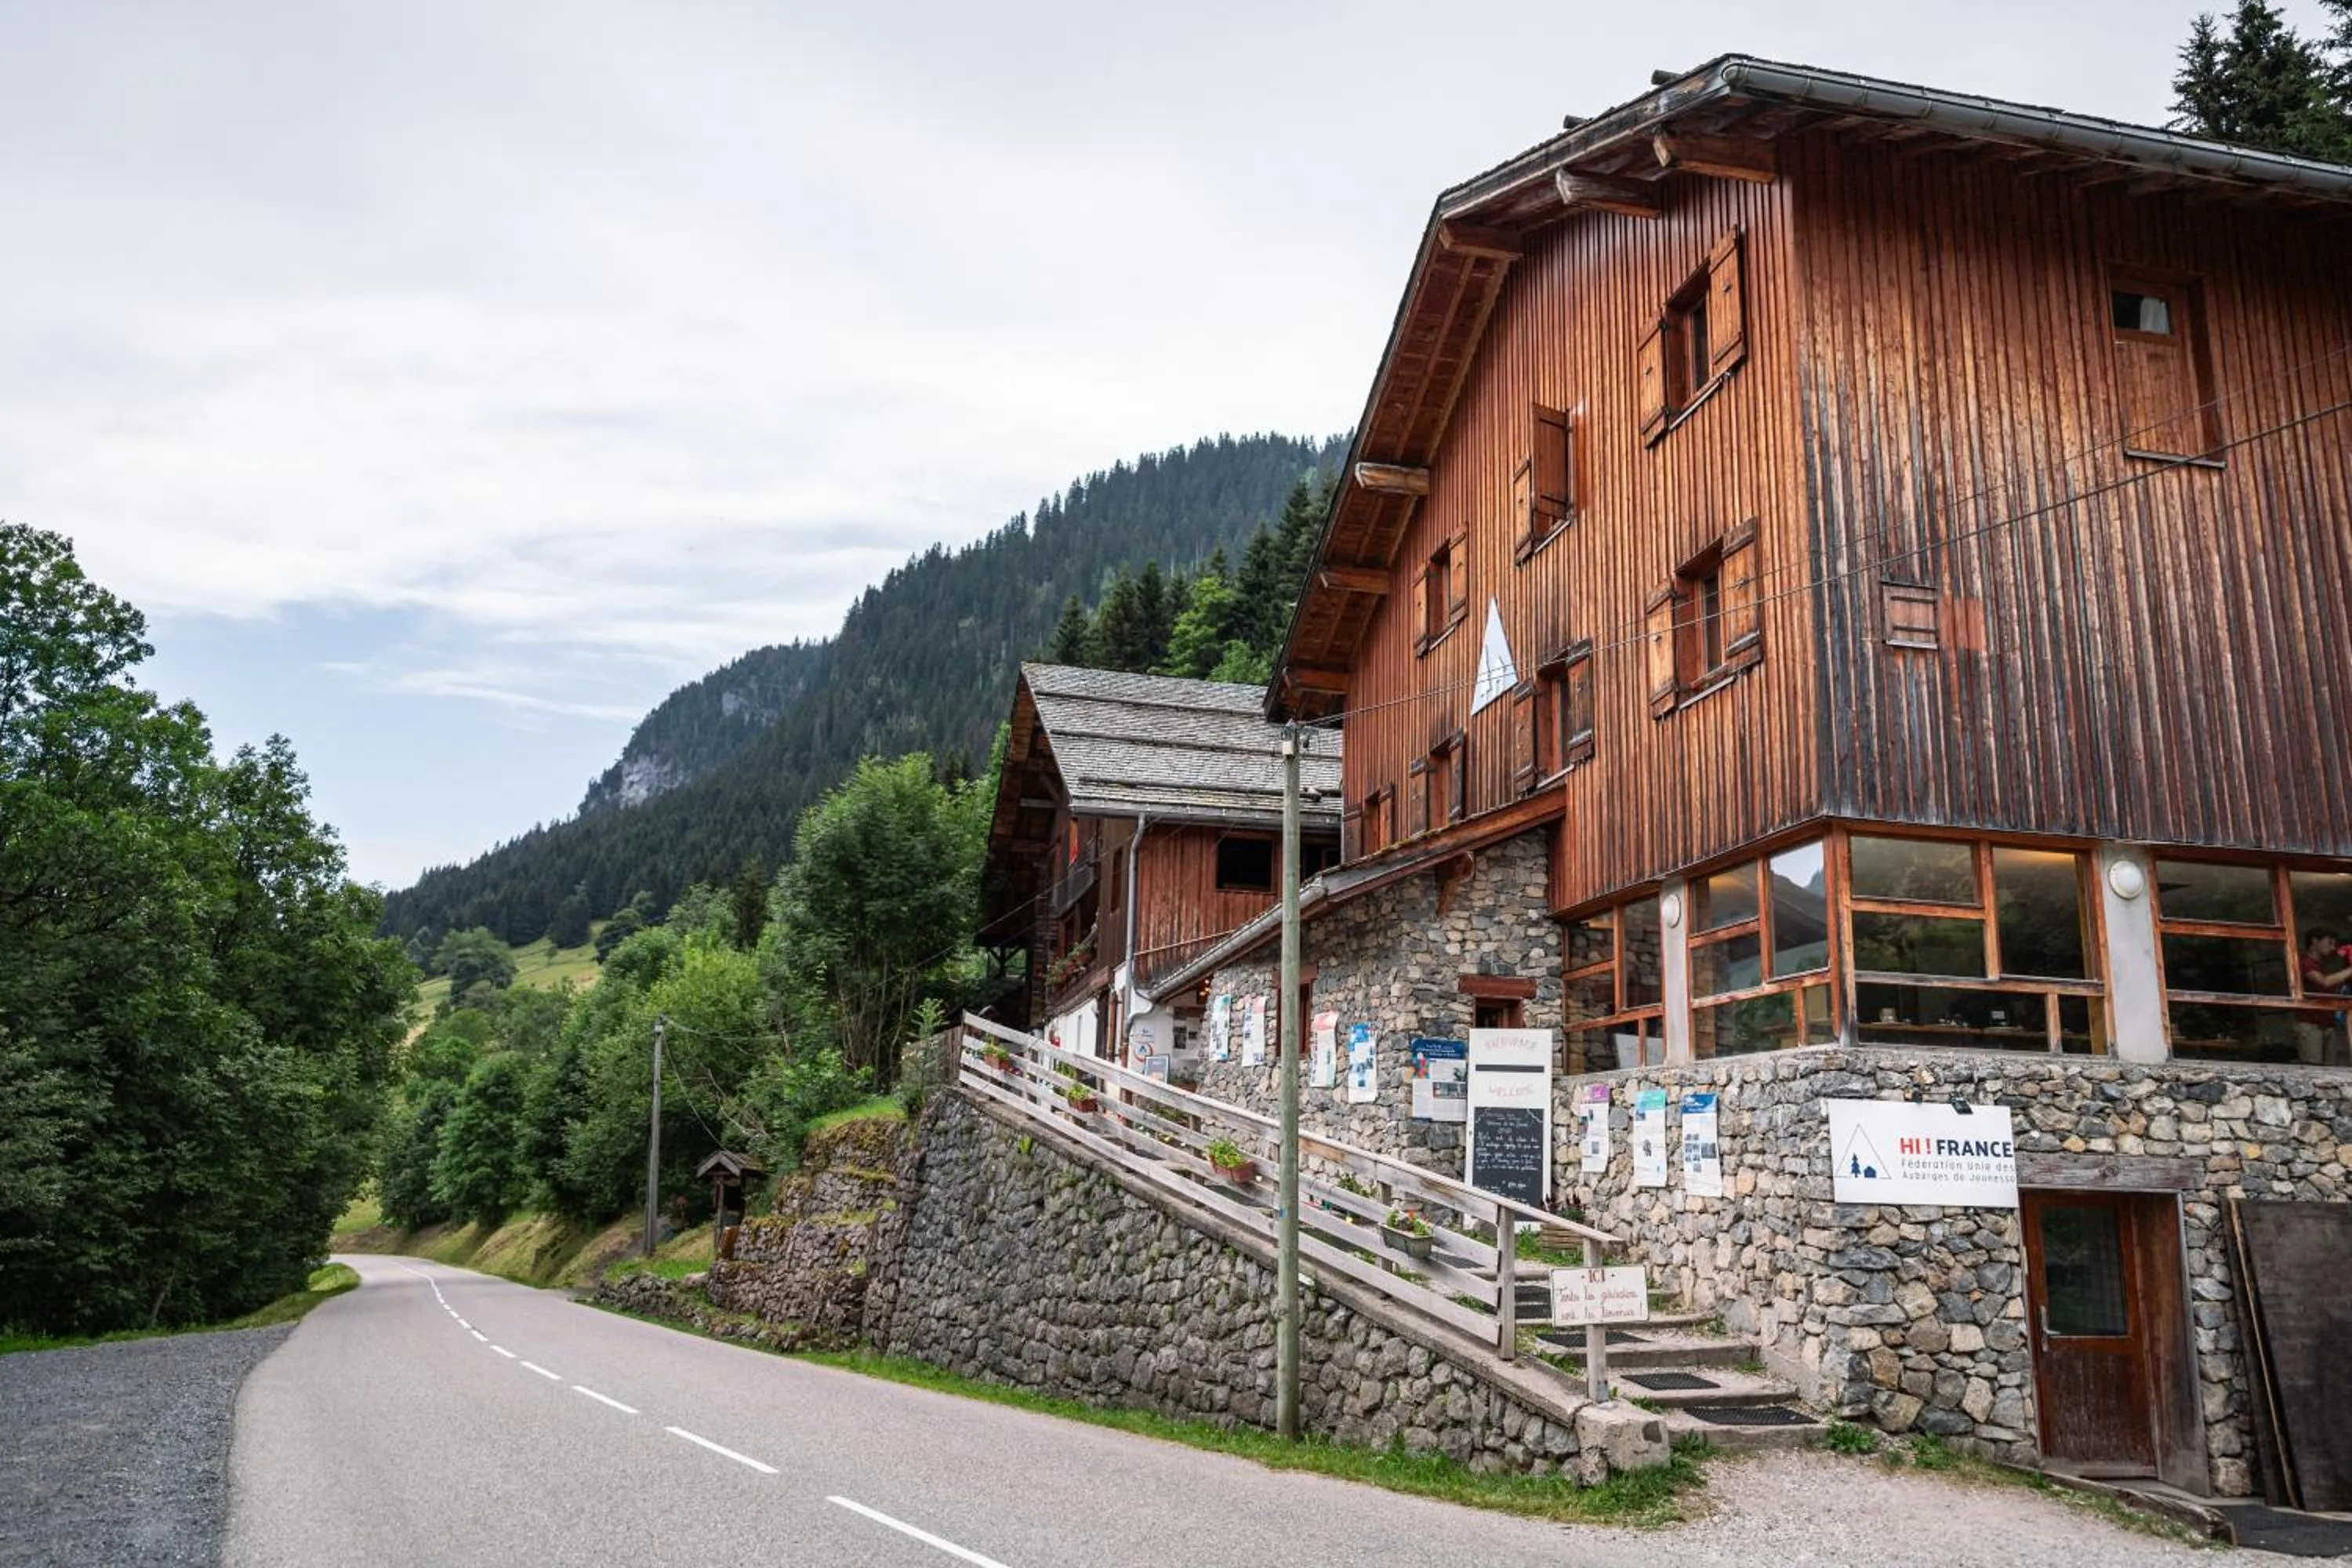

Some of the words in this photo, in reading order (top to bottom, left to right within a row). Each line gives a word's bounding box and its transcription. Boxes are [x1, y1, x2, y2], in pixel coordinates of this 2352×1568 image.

[1936, 1138, 2013, 1158] FRANCE
[1901, 1158, 1962, 1171] Fédération
[1967, 1161, 1991, 1171] Unie
[1995, 1162, 2014, 1172] des
[1902, 1171, 1948, 1181] Auberges
[1953, 1173, 1965, 1181] de
[1588, 1269, 1606, 1283] ICI
